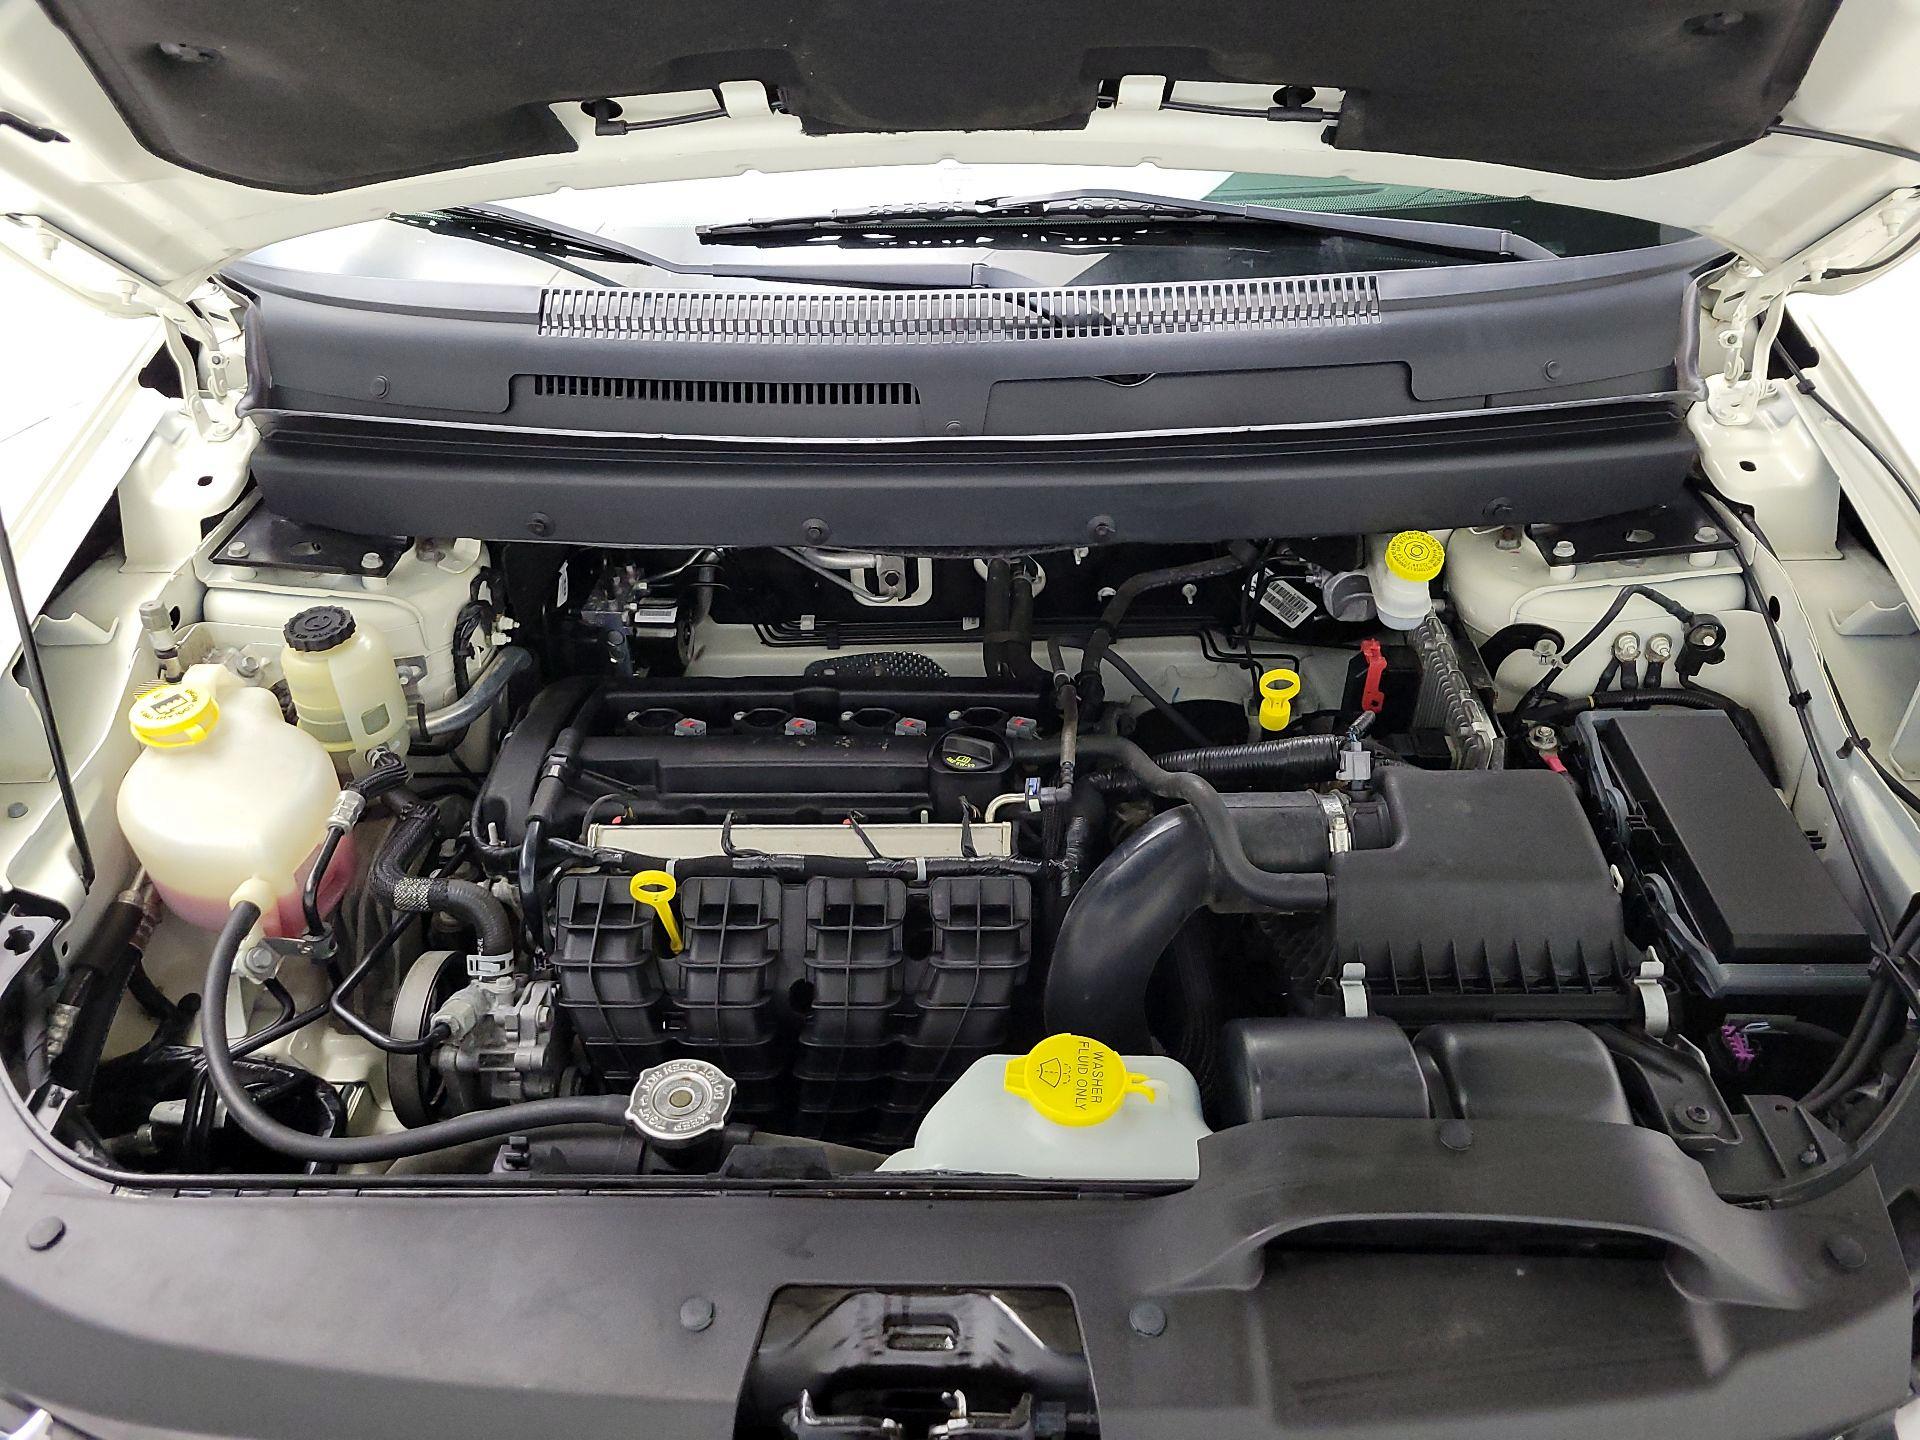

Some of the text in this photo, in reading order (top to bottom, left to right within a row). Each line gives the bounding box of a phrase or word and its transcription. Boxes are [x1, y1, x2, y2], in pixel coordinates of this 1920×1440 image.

[664, 1064, 697, 1075] OPEN
[699, 1068, 719, 1085] NOT
[1075, 1041, 1089, 1110] FLUID ONLY
[1091, 1051, 1104, 1103] WASHER
[674, 1114, 710, 1131] KEEP
